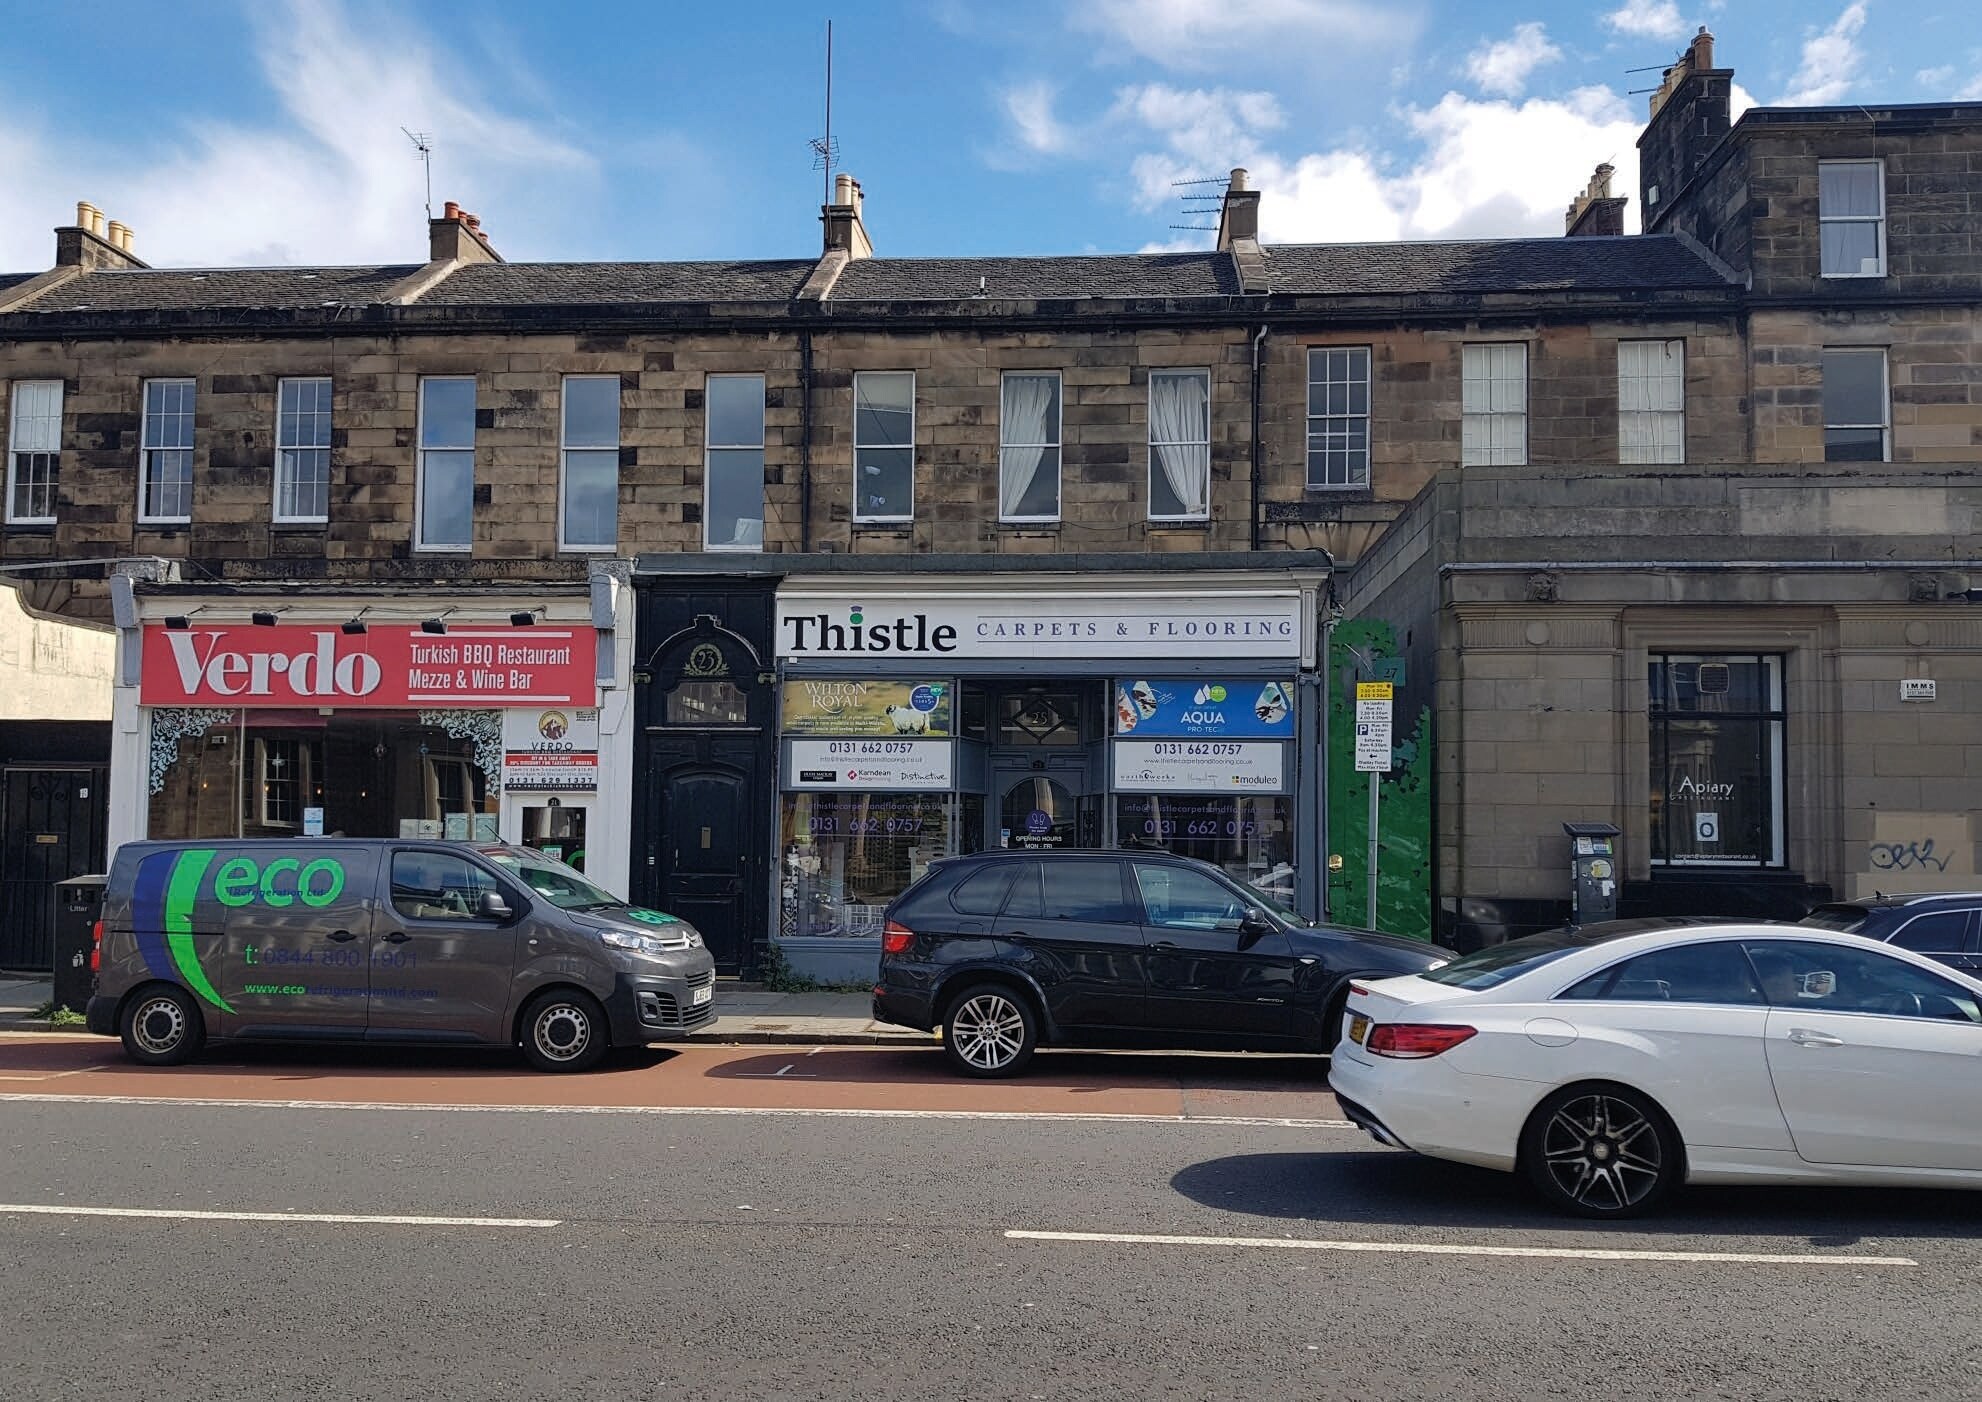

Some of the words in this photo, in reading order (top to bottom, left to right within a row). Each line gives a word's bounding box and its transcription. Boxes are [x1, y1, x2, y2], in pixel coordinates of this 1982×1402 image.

[783, 613, 957, 652] Thistle
[977, 622, 1097, 636] CARPETS
[1116, 622, 1128, 636] &
[1148, 621, 1292, 636] FLOORING
[410, 645, 458, 665] Turkish
[463, 645, 493, 667] BBQ
[498, 644, 570, 665] Restaurant
[698, 650, 715, 671] 23
[161, 631, 381, 696] Verdo
[408, 669, 451, 689] Mezze
[456, 669, 467, 689] &
[471, 669, 504, 689] Wine
[510, 669, 533, 689] Bar
[1384, 668, 1397, 678] 27
[805, 682, 867, 695] WILTON
[812, 695, 863, 710] ROYAL
[1032, 711, 1049, 725] 25
[1180, 711, 1226, 725] AQUA
[1360, 725, 1368, 735] P
[531, 742, 573, 751] VERDO
[829, 743, 856, 754] 0131
[861, 743, 882, 754] 662
[885, 743, 913, 754] 0757
[1154, 744, 1182, 755] 0131
[1187, 744, 1209, 755] 662
[1213, 744, 1242, 755] 0757
[858, 769, 892, 777] Karndean
[901, 771, 947, 781] Distinctive
[1240, 775, 1278, 784] moduleo
[1678, 775, 1734, 796] Apiary
[788, 802, 942, 811] inf@thistlecarpetandfloorin.co.uk
[1124, 803, 1286, 815] info@tistlecarpetsandflorin.uk
[808, 817, 839, 832] 0131
[849, 817, 878, 832] 662
[886, 817, 923, 832] 0757
[1144, 820, 1177, 834] 0131
[1187, 820, 1217, 835] 662
[214, 858, 345, 907] eco
[69, 904, 88, 912] Litter
[245, 944, 258, 965] t:
[263, 947, 314, 966] 0844
[320, 948, 360, 967] 800
[371, 950, 418, 969] 1901
